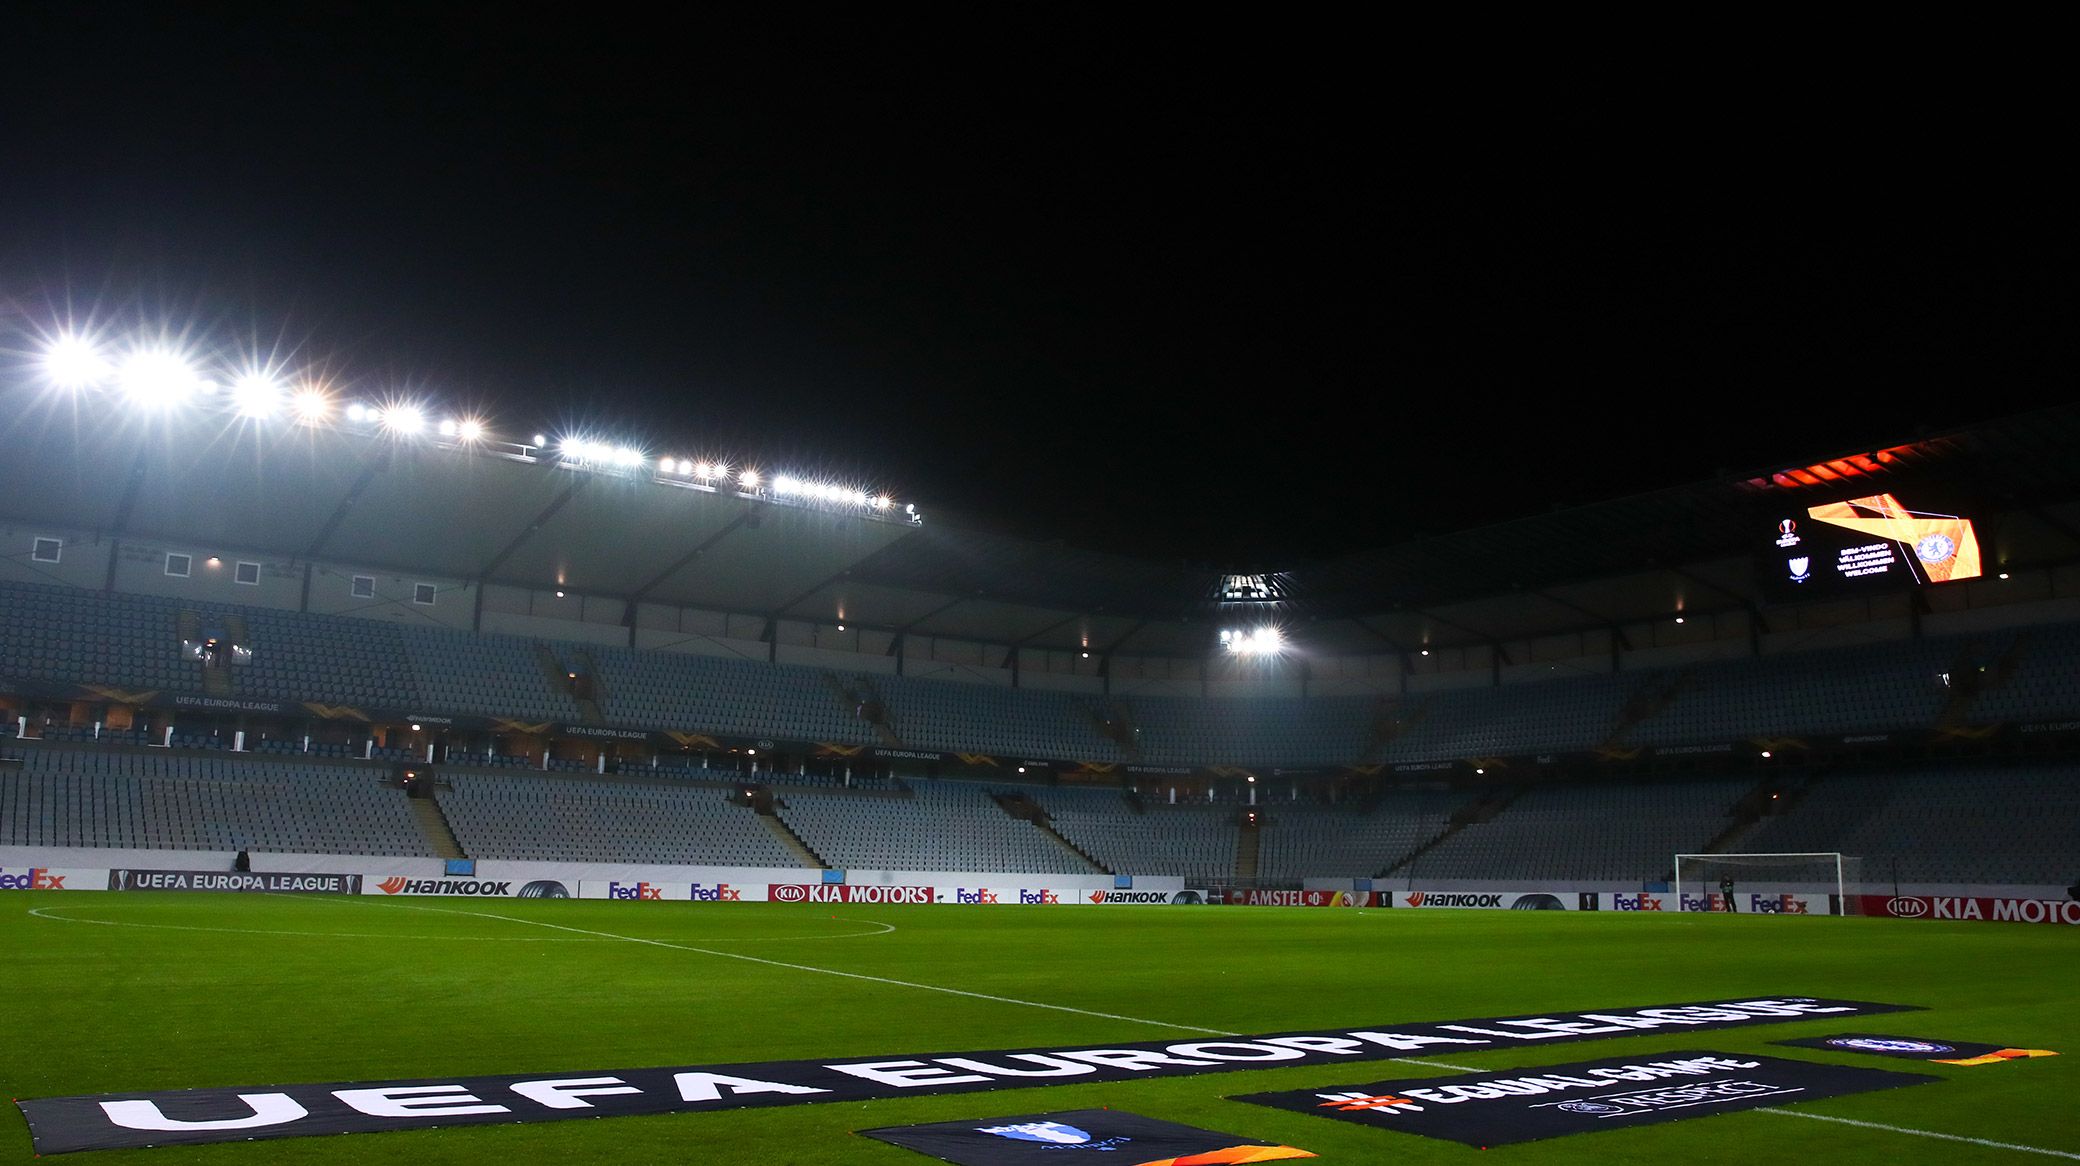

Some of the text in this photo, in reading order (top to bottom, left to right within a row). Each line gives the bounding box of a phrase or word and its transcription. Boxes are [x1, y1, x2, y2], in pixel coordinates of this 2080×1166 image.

[1837, 557, 1895, 571] WILLKOMMEN
[1845, 566, 1888, 577] WELCOME
[176, 696, 280, 712] UEFA EUROPA LEAGUE
[566, 727, 648, 739] UEFA EUROPA LEAGUE
[875, 749, 940, 761] UEFA EUROPA LEAGUE
[0, 868, 65, 889] edEx
[136, 873, 339, 891] UEFA EUROPA LEAGUE
[609, 882, 662, 900] FedEx
[690, 883, 741, 901] FedEx
[809, 886, 929, 904] KIA MOTORS
[957, 888, 998, 904] FedEx
[1020, 889, 1059, 905] FedEx
[1249, 890, 1306, 906] AMSTEL
[1613, 894, 1662, 911] FedEx
[1751, 894, 1809, 913] FedEx
[1933, 896, 1983, 920] KIA
[97, 1000, 1860, 1133] UEFA EUROPA LEAGUE
[1608, 1080, 1780, 1107] RESPECT
